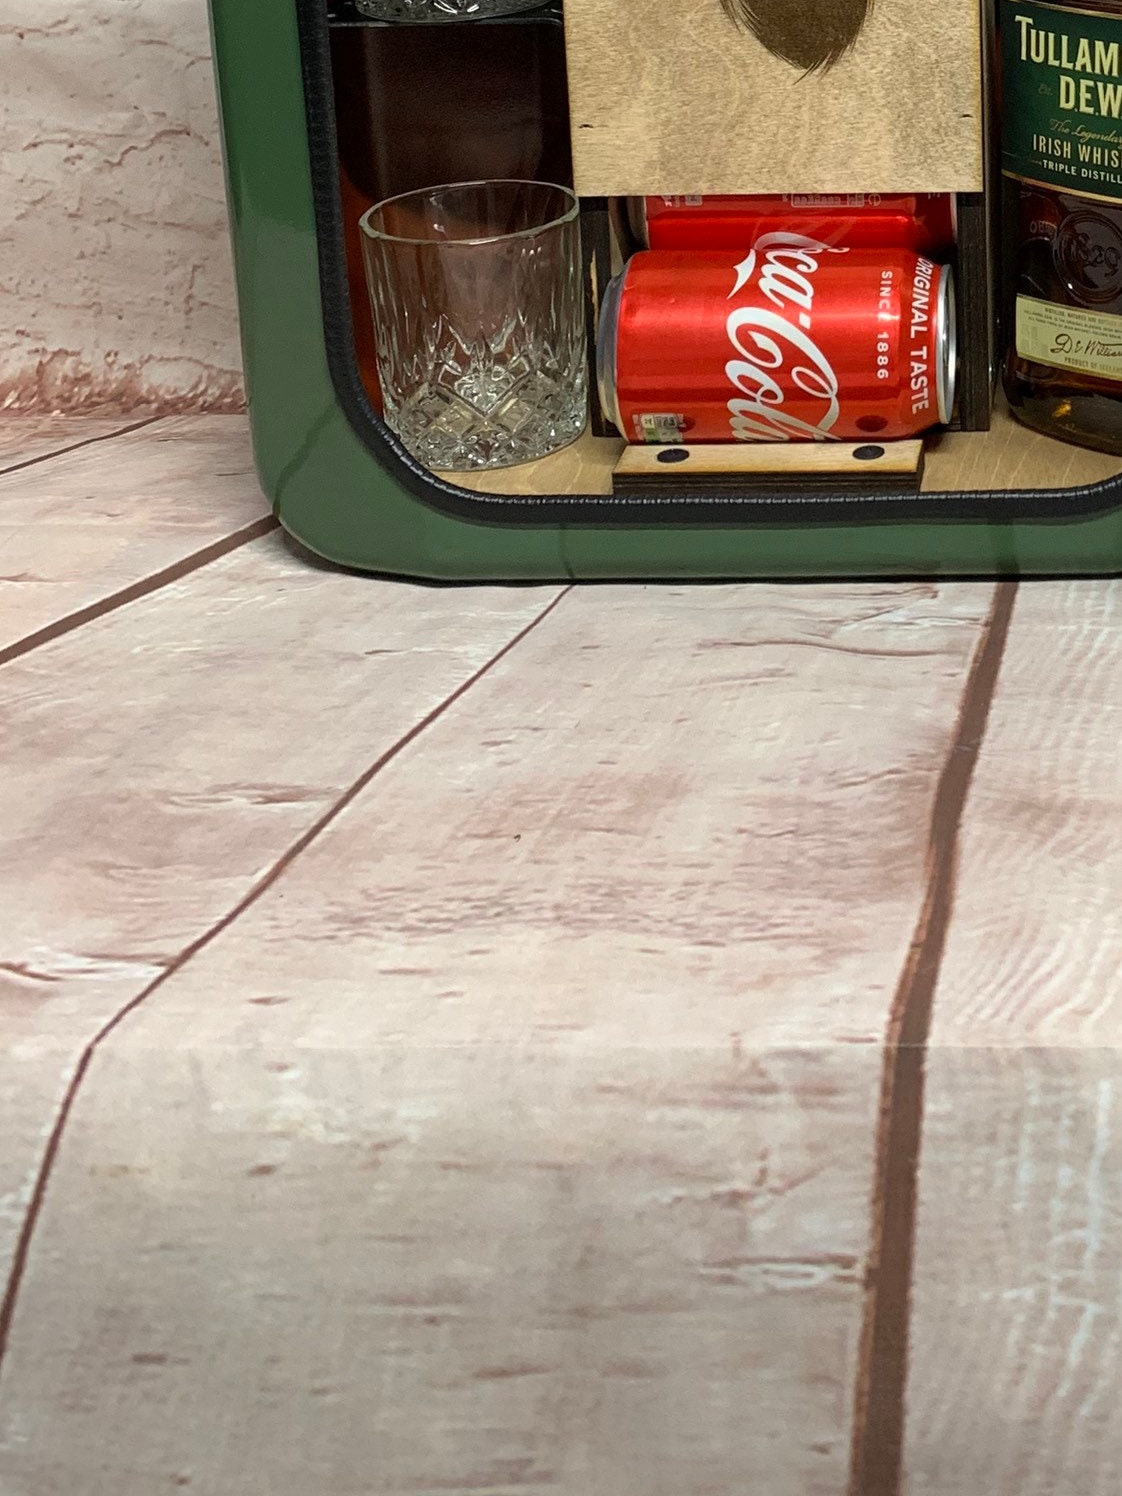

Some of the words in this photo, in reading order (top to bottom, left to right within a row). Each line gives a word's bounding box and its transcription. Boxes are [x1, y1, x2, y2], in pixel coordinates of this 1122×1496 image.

[1033, 134, 1072, 159] IRISH
[1049, 118, 1072, 135] The
[1042, 159, 1077, 176] TRIPLE
[879, 270, 893, 322] SINCE
[910, 256, 935, 339] ORIGINAL
[725, 247, 850, 442] ca-Cola
[877, 331, 890, 380] 1886
[910, 345, 930, 415] TASTE
